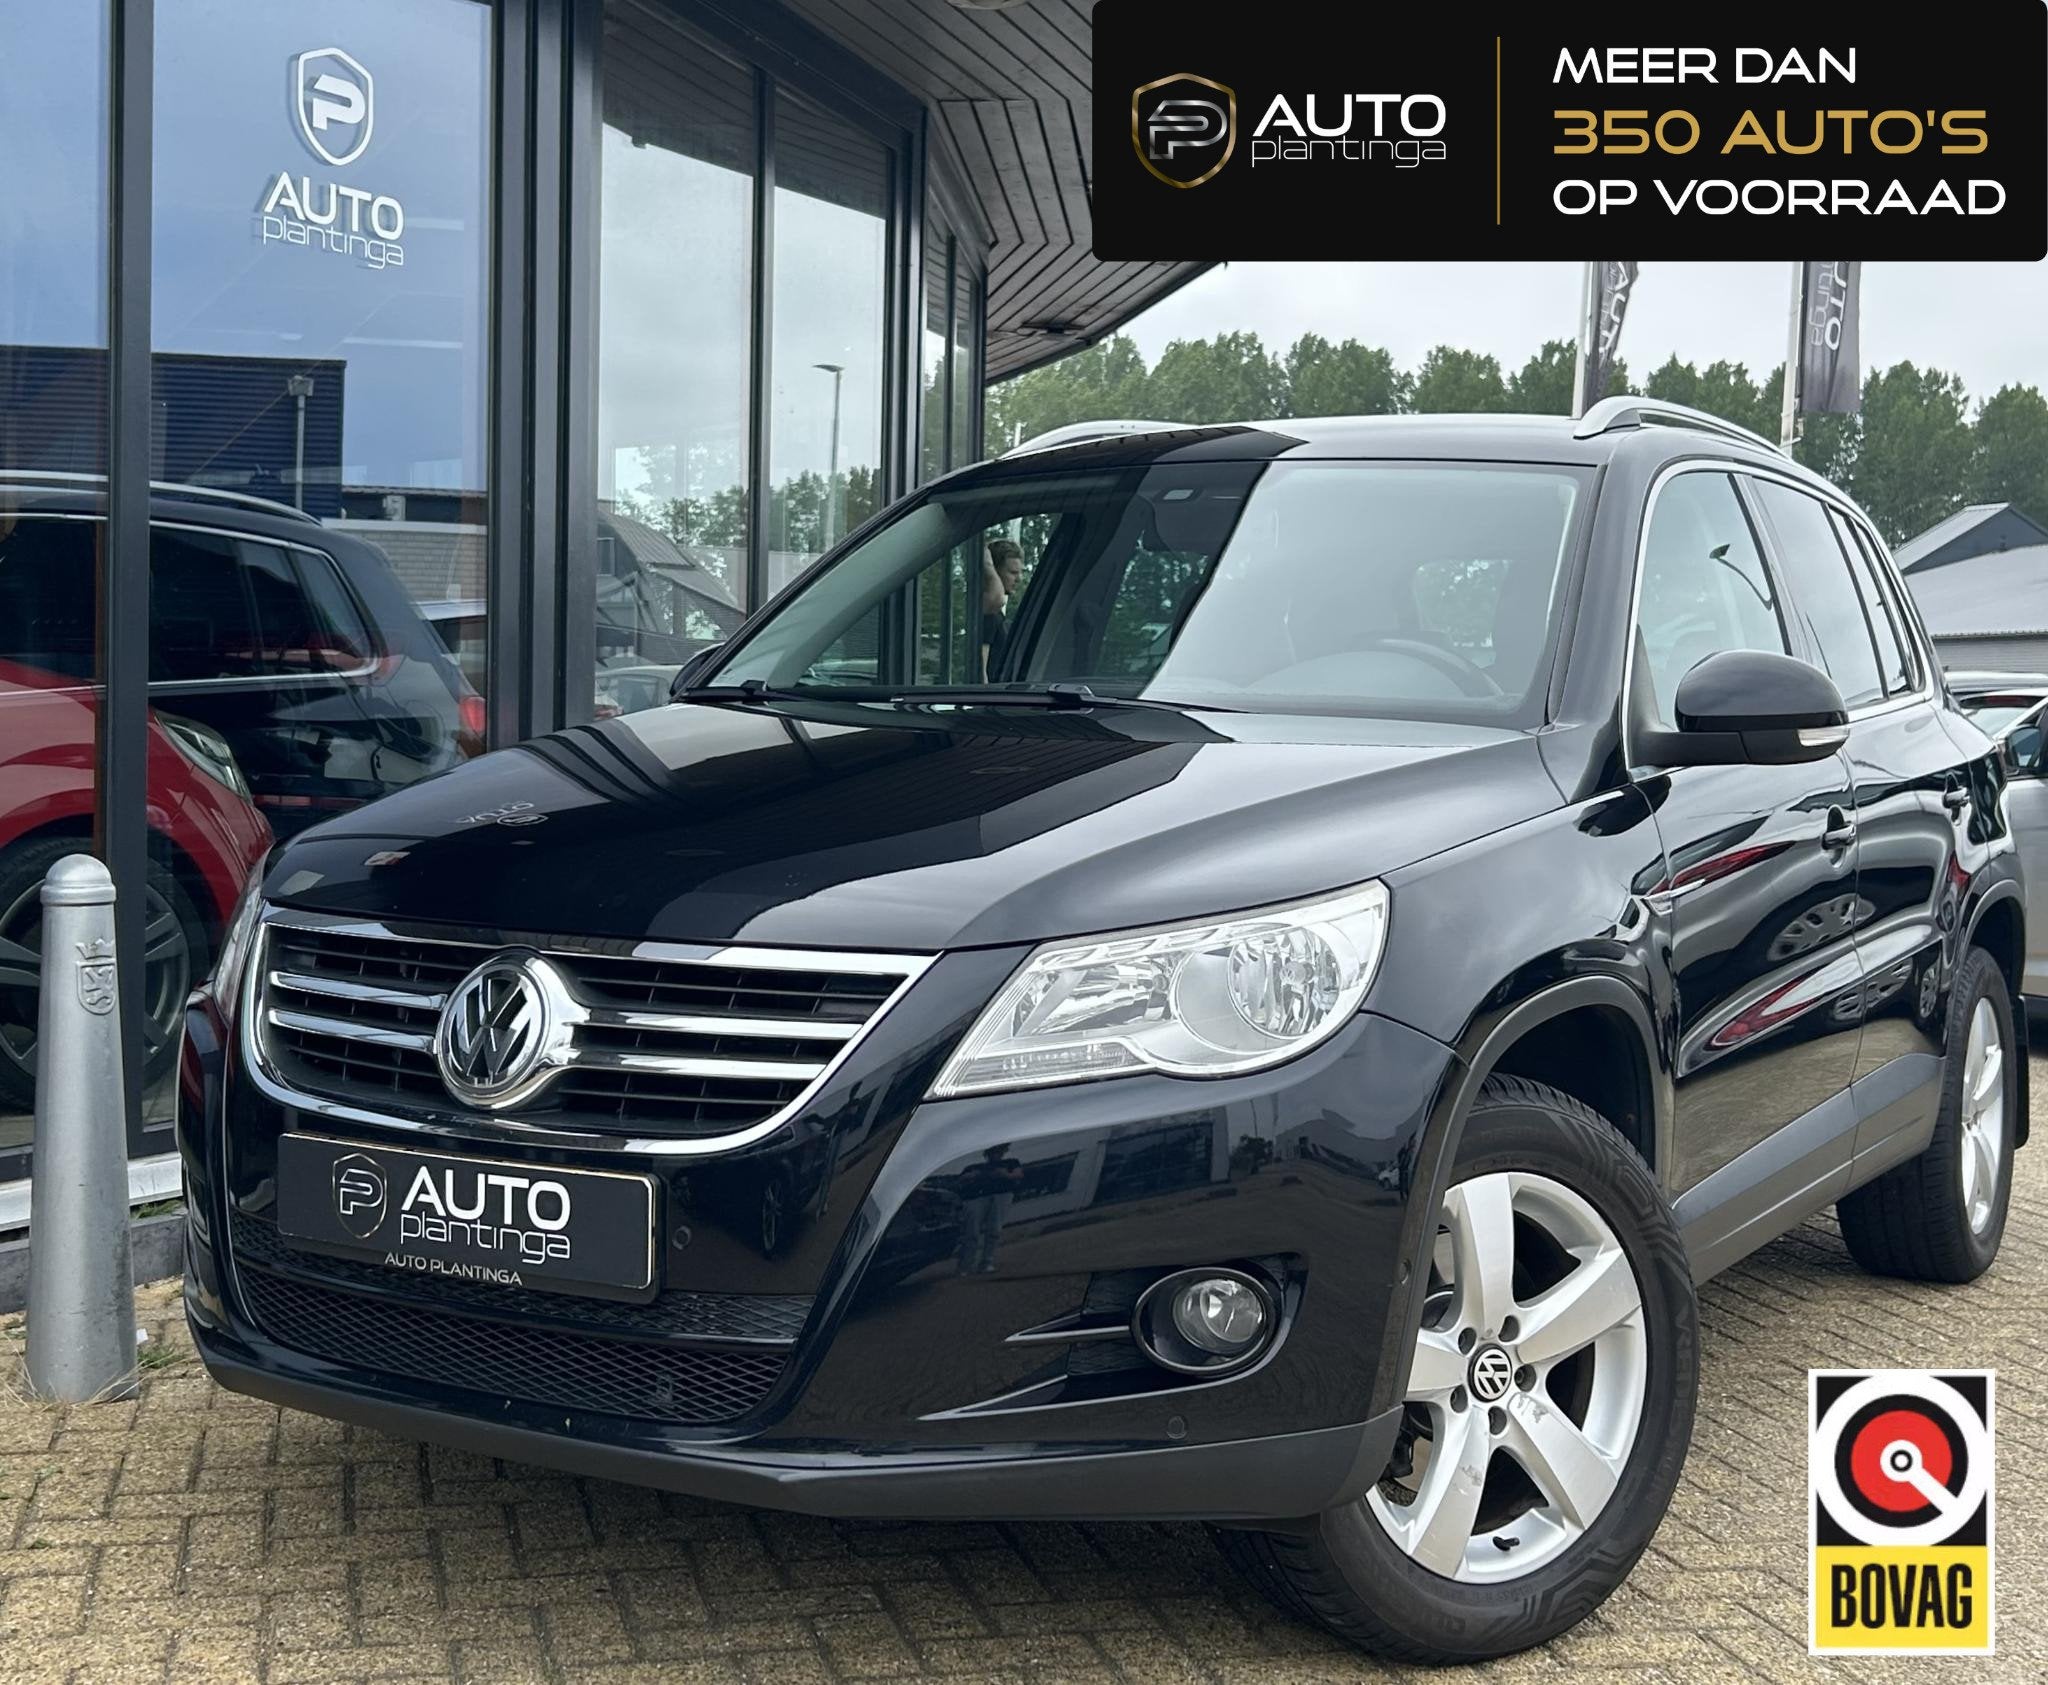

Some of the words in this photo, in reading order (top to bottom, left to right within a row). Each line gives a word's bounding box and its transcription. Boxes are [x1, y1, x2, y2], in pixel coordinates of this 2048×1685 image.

[264, 171, 404, 240] AUTO
[263, 216, 404, 269] plantinga
[1825, 261, 1847, 350] UTO
[401, 1165, 571, 1231] AUTO
[400, 1210, 571, 1265] plantinga
[385, 1252, 427, 1270] AUTO
[430, 1259, 523, 1286] PLANTINGA
